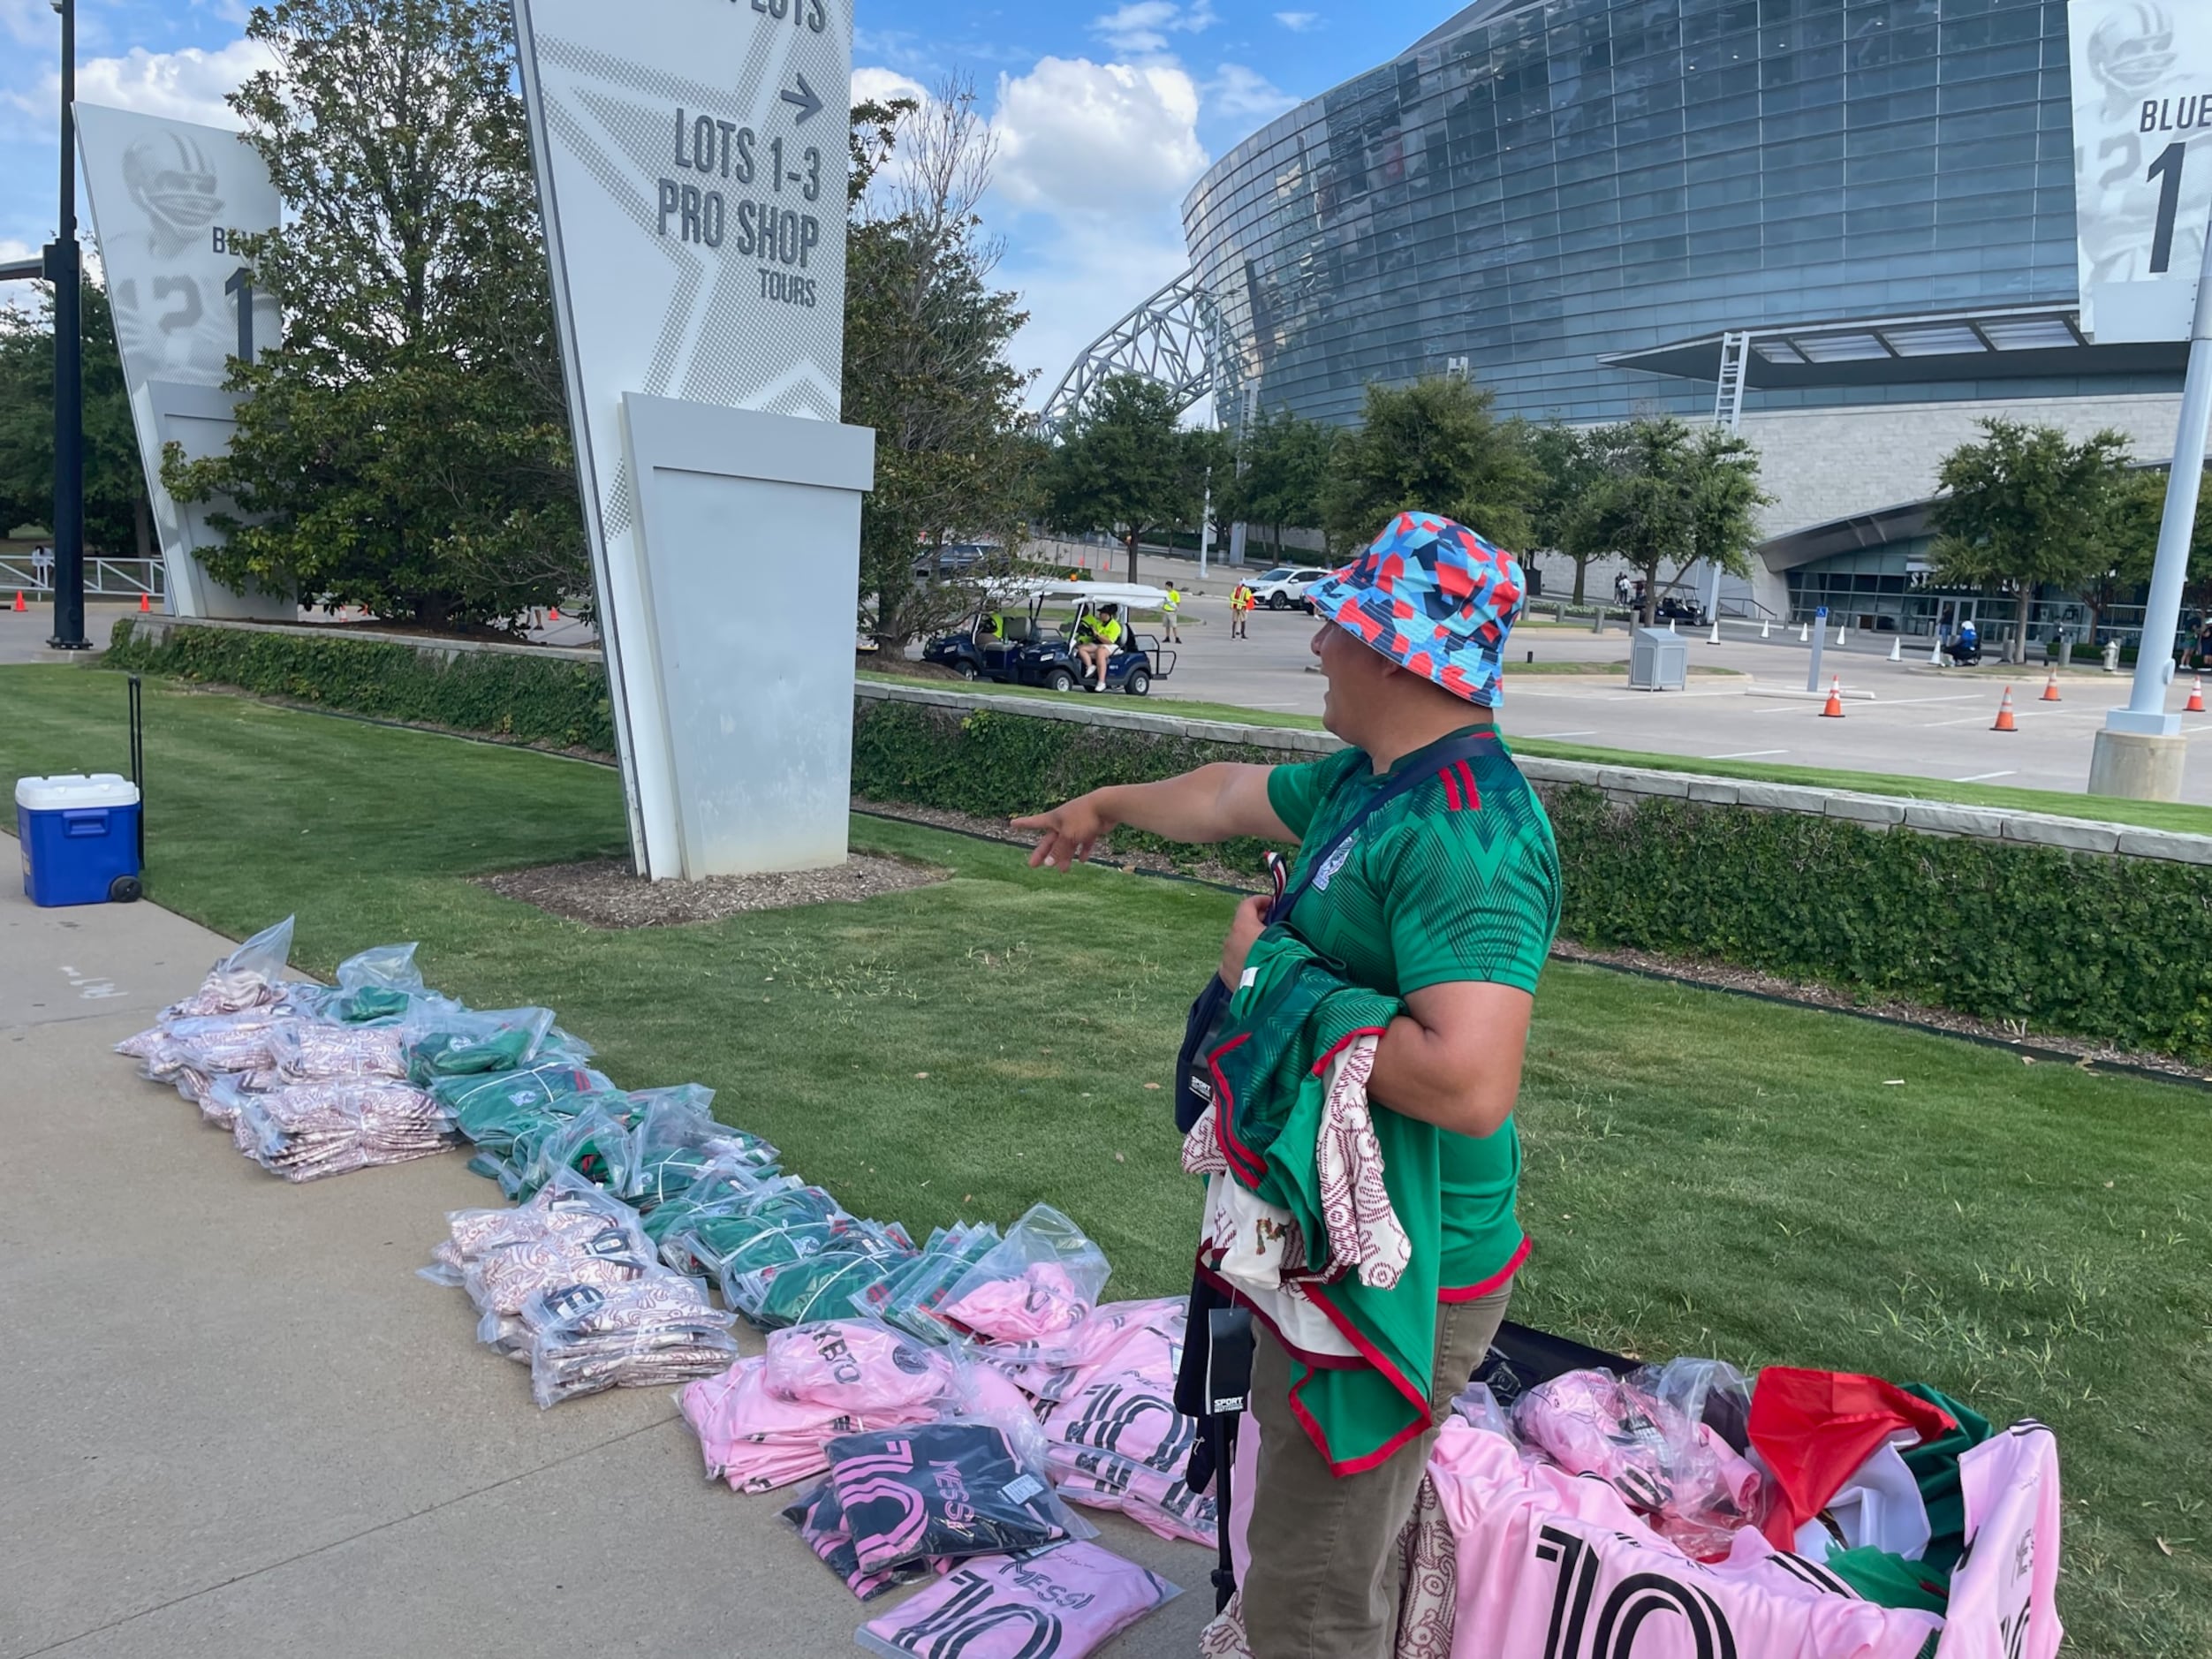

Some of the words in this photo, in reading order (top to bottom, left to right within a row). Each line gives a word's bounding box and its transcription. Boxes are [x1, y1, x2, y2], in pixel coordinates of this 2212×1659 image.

[675, 108, 755, 184] LOTS
[770, 137, 820, 201] 1-3
[2140, 95, 2212, 133] BLUE
[658, 178, 724, 248] PRO
[738, 200, 819, 268] SHOP
[2147, 142, 2186, 273] 1
[225, 268, 253, 369] 1
[758, 268, 816, 307] TOURS
[1214, 1397, 1244, 1406] SPORT
[928, 1459, 978, 1538] MESSI
[891, 1570, 1062, 1659] 10
[998, 1561, 1095, 1610] MESSI
